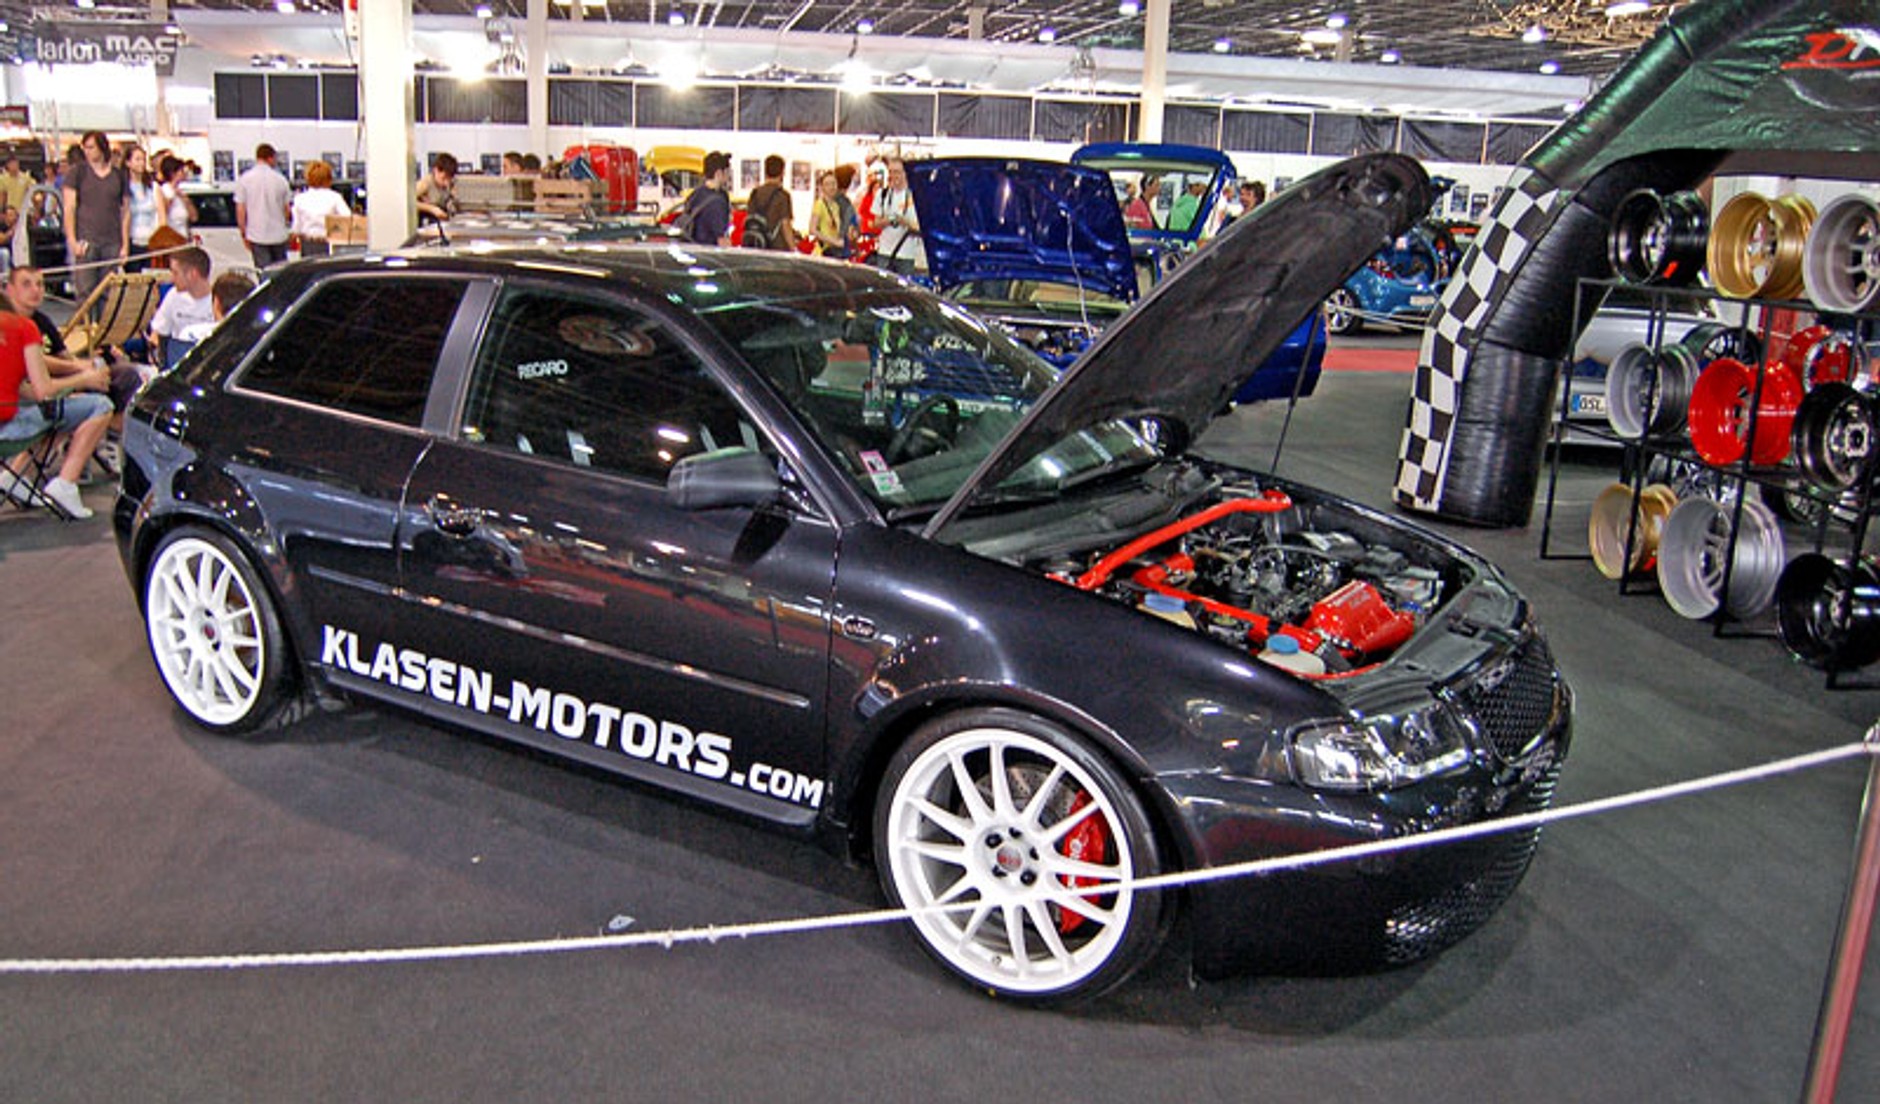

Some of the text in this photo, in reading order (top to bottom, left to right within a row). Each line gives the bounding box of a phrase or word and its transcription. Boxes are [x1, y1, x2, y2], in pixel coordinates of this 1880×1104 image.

[105, 34, 176, 52] MAC
[115, 53, 170, 66] AUDIO
[517, 359, 569, 380] RECARO
[321, 625, 824, 808] KLASEN-MOTORS.COM
